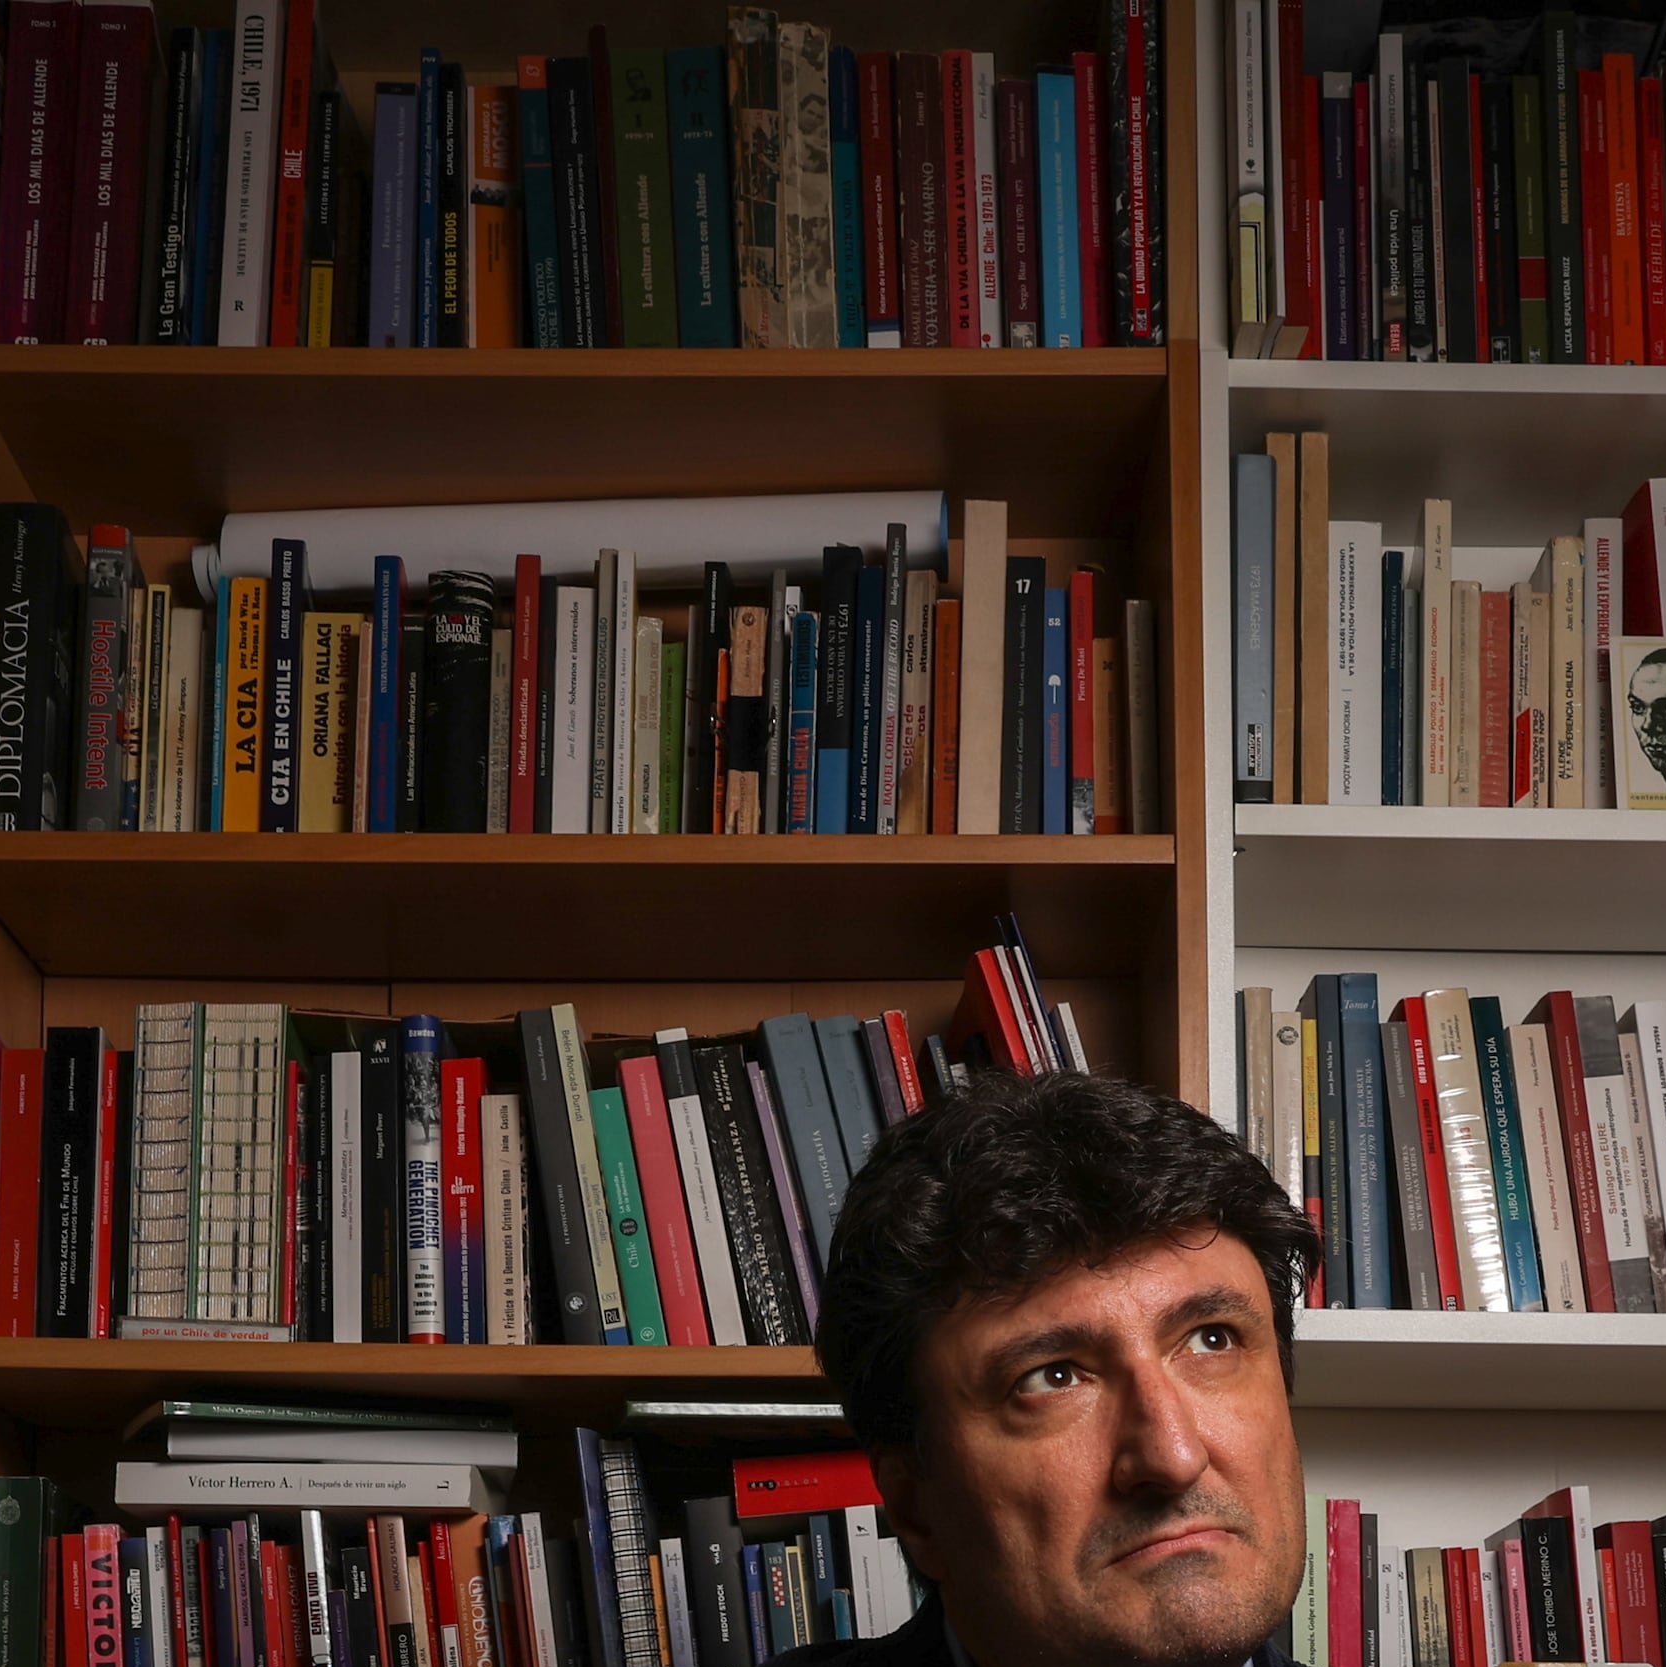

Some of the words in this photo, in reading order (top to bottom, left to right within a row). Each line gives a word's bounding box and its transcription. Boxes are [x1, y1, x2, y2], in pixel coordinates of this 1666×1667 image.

[241, 15, 264, 75] CHILE,
[33, 58, 48, 107] ALLENDE
[103, 61, 118, 110] ALLENDE
[240, 81, 260, 111] 1971
[32, 110, 45, 125] DE
[102, 113, 115, 127] DE
[30, 128, 44, 155] DIAS
[100, 130, 114, 158] DIAS
[28, 158, 42, 179] MIL
[98, 160, 112, 181] MIL
[27, 182, 41, 204] LOS
[97, 184, 111, 206] LOS
[445, 212, 457, 250] TODOS
[444, 251, 457, 266] DE
[444, 268, 457, 298] PEOR
[444, 300, 457, 314] EL
[436, 615, 447, 625] LA
[472, 615, 481, 626] EL
[436, 624, 462, 634] CULTO
[466, 625, 481, 635] DEL
[436, 633, 482, 645] ESPIONAJE
[88, 619, 117, 706] Hostile
[315, 623, 331, 684] FALLACI
[275, 658, 291, 718] CHILE
[236, 678, 257, 729] CIA
[274, 722, 289, 749] EN
[313, 691, 329, 757] ORIANA
[85, 712, 113, 790] Intent
[235, 734, 256, 773] LA
[271, 757, 290, 805] CIA
[425, 1160, 438, 1183] THE
[408, 1160, 424, 1249] GENERATION
[425, 1187, 439, 1249] PINOCHET
[141, 1328, 159, 1336] por
[181, 1328, 207, 1337] Chile
[213, 1329, 227, 1338] de
[230, 1330, 269, 1341] verdad
[188, 1475, 225, 1488] Víctor
[229, 1476, 275, 1488] Herrero
[279, 1477, 292, 1488] A.
[308, 1479, 341, 1490] Después
[342, 1479, 353, 1488] de
[387, 1480, 406, 1490] siglo
[1536, 1532, 1547, 1546] C.
[1539, 1545, 1551, 1588] MERINO
[1542, 1588, 1556, 1629] TORIBIO
[1545, 1630, 1559, 1655] JOSE
